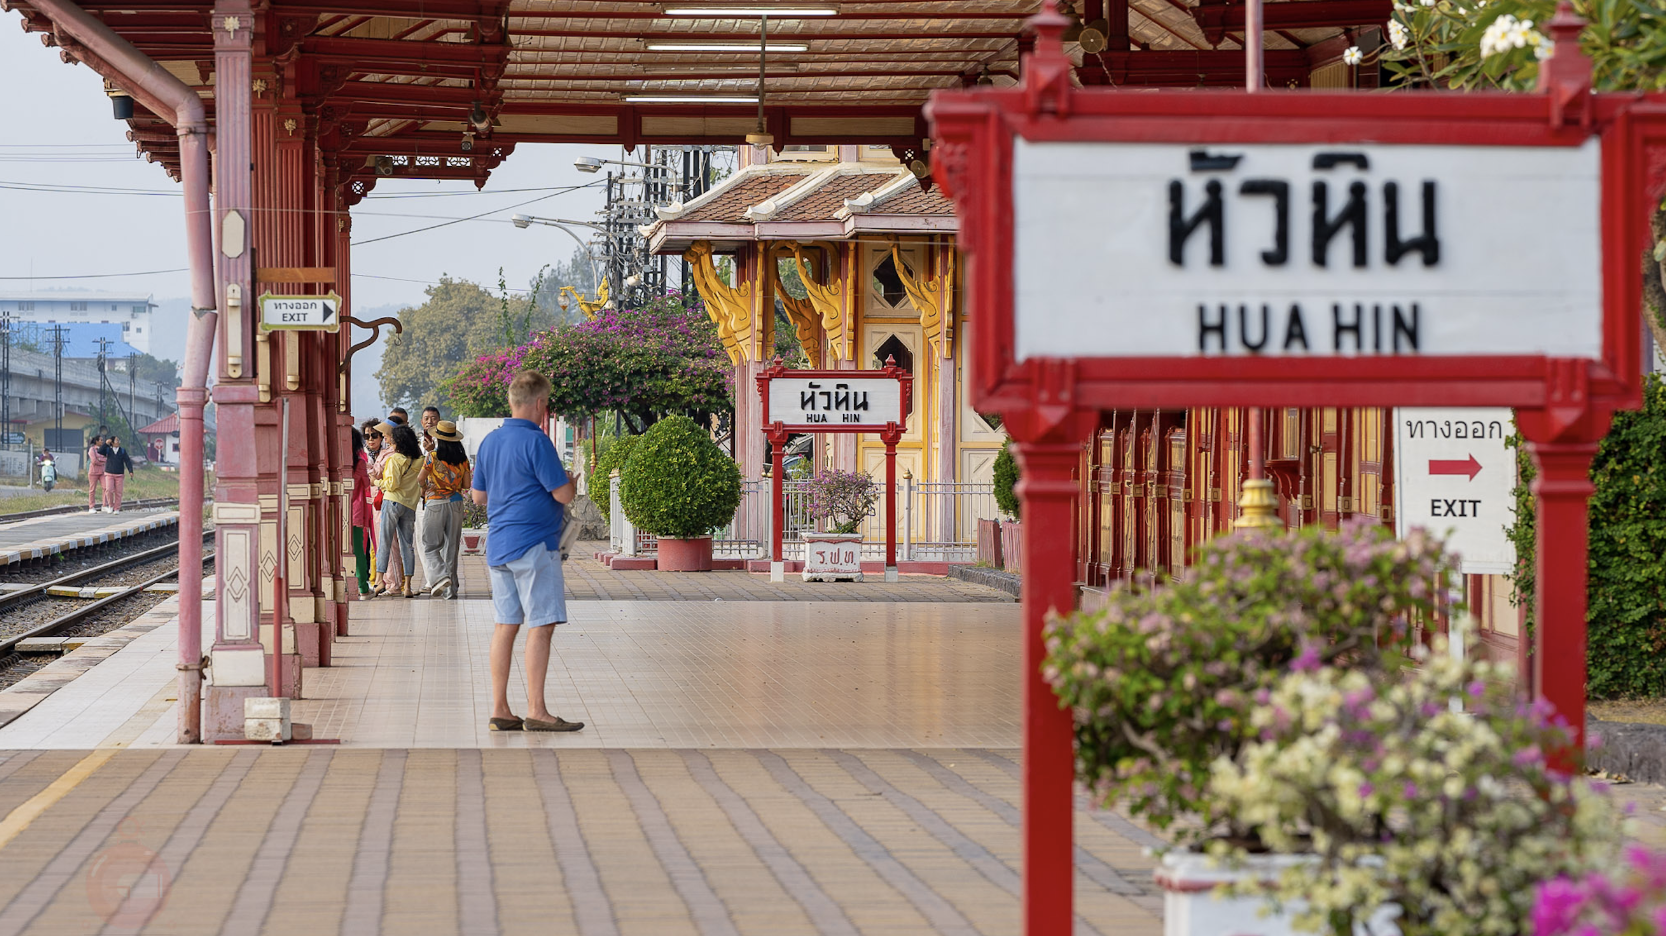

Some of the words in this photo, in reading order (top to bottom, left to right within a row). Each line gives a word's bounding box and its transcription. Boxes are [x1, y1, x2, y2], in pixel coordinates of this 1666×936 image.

[1168, 150, 1440, 267] หัวหิน
[273, 302, 318, 310] ทางออก
[282, 313, 308, 322] EXIT
[1199, 303, 1308, 351] HUA
[1333, 303, 1418, 351] HIN
[800, 381, 869, 411] หัวหิน
[806, 413, 828, 423] HUA
[842, 413, 860, 423] HIN
[1405, 420, 1502, 439] ทางออก
[1431, 499, 1482, 517] EXIT
